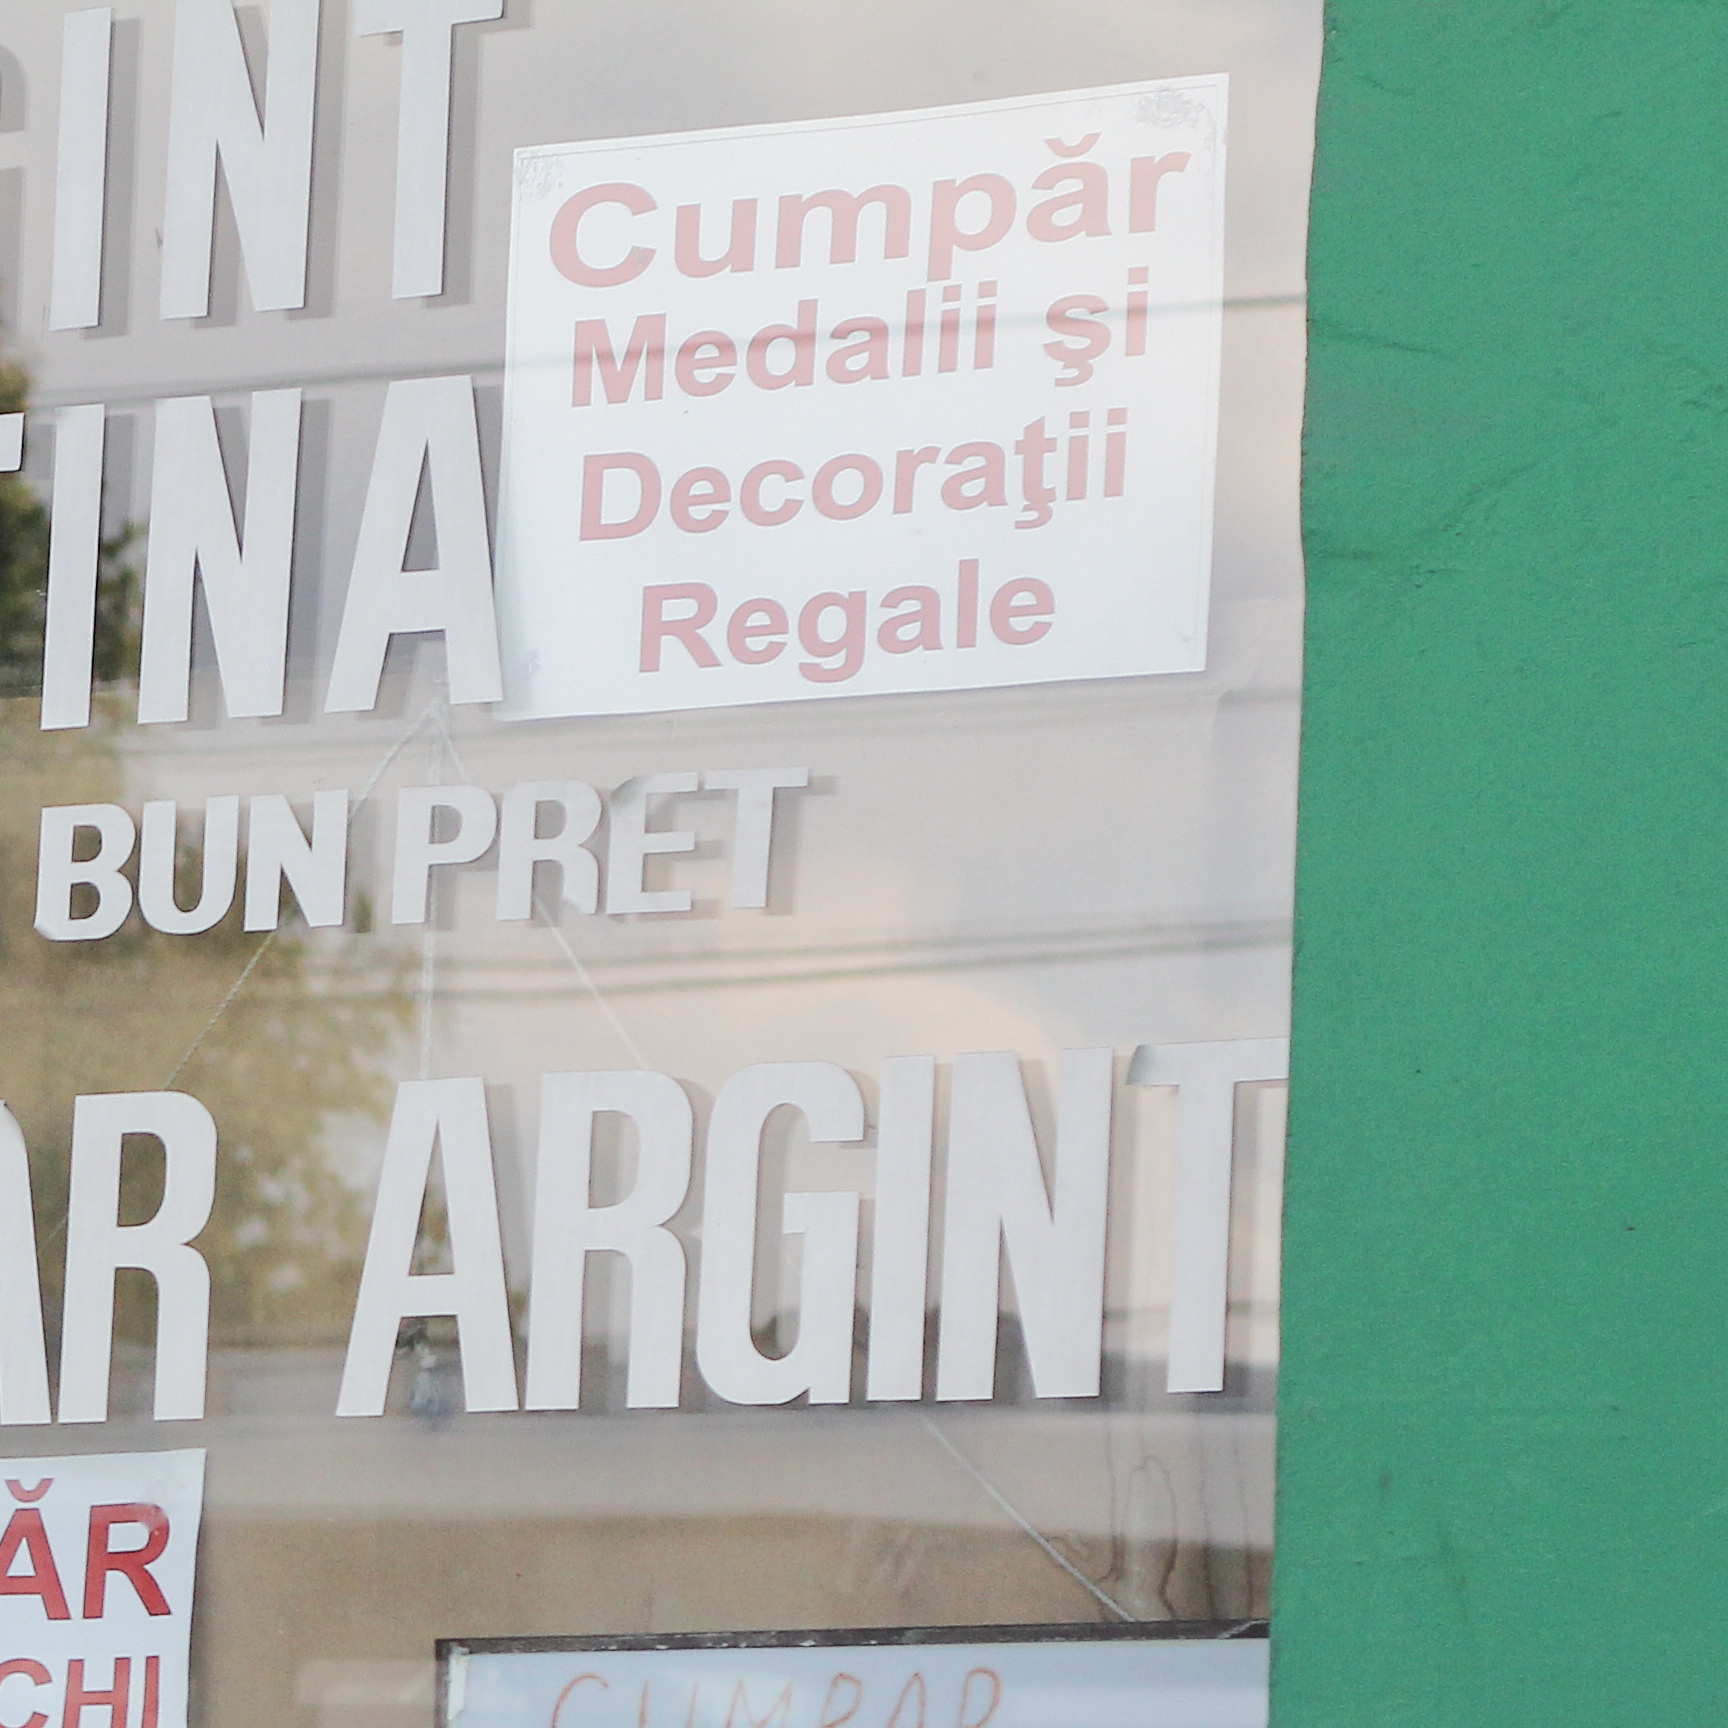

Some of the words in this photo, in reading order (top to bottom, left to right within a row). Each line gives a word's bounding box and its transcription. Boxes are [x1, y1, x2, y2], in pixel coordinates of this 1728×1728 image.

[549, 132, 1192, 289] Cumpăr
[571, 280, 999, 409] Medalii
[638, 559, 1056, 684] Regale
[34, 789, 349, 944] BUN
[391, 767, 809, 925] PRET
[335, 1037, 1289, 1418] ARGINT
